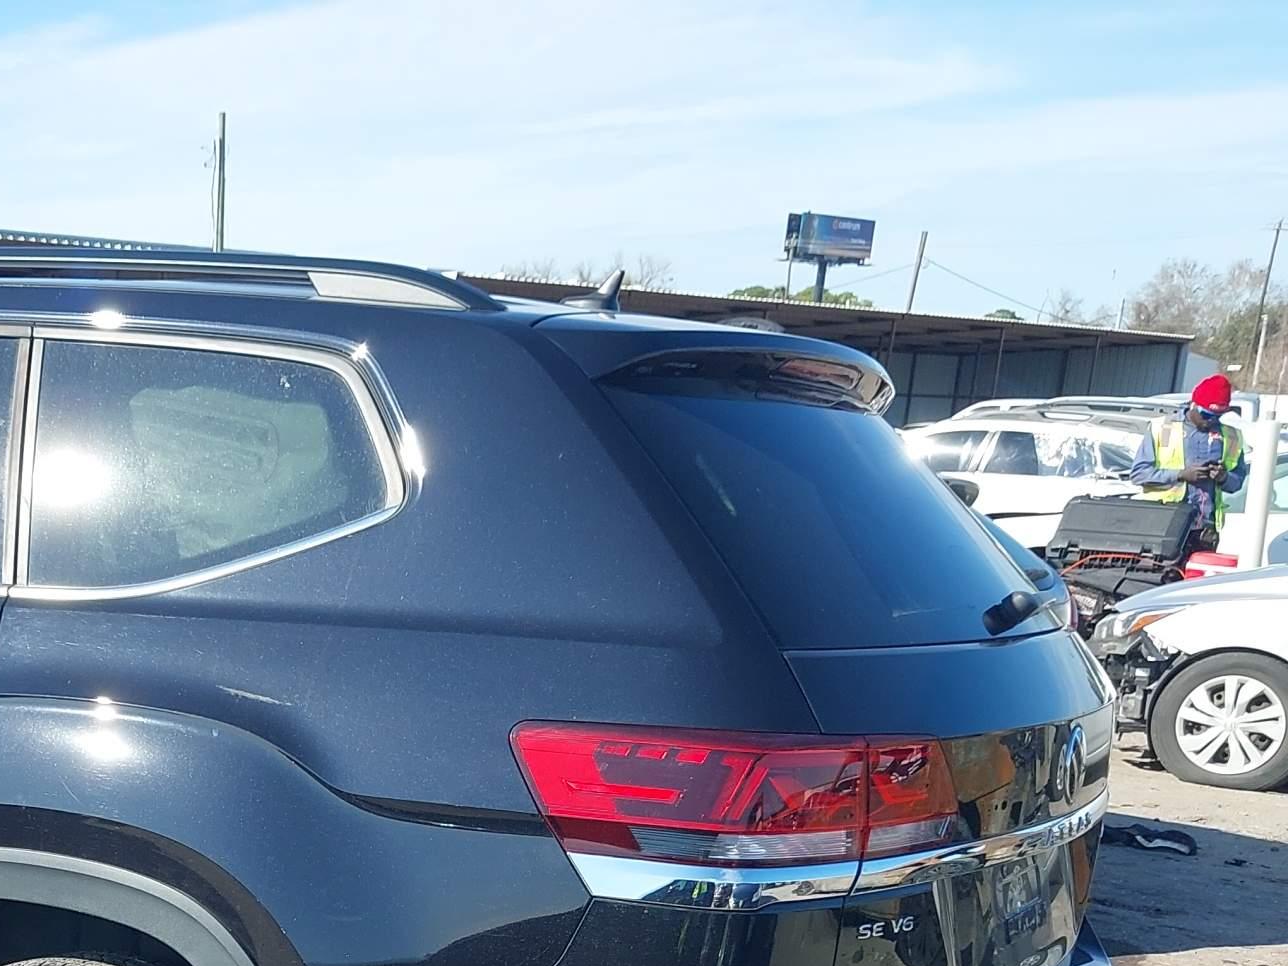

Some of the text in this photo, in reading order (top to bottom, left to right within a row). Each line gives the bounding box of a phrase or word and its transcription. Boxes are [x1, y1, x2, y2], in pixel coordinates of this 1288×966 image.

[1045, 811, 1093, 847] ATLAS
[857, 916, 915, 940] SE V6
